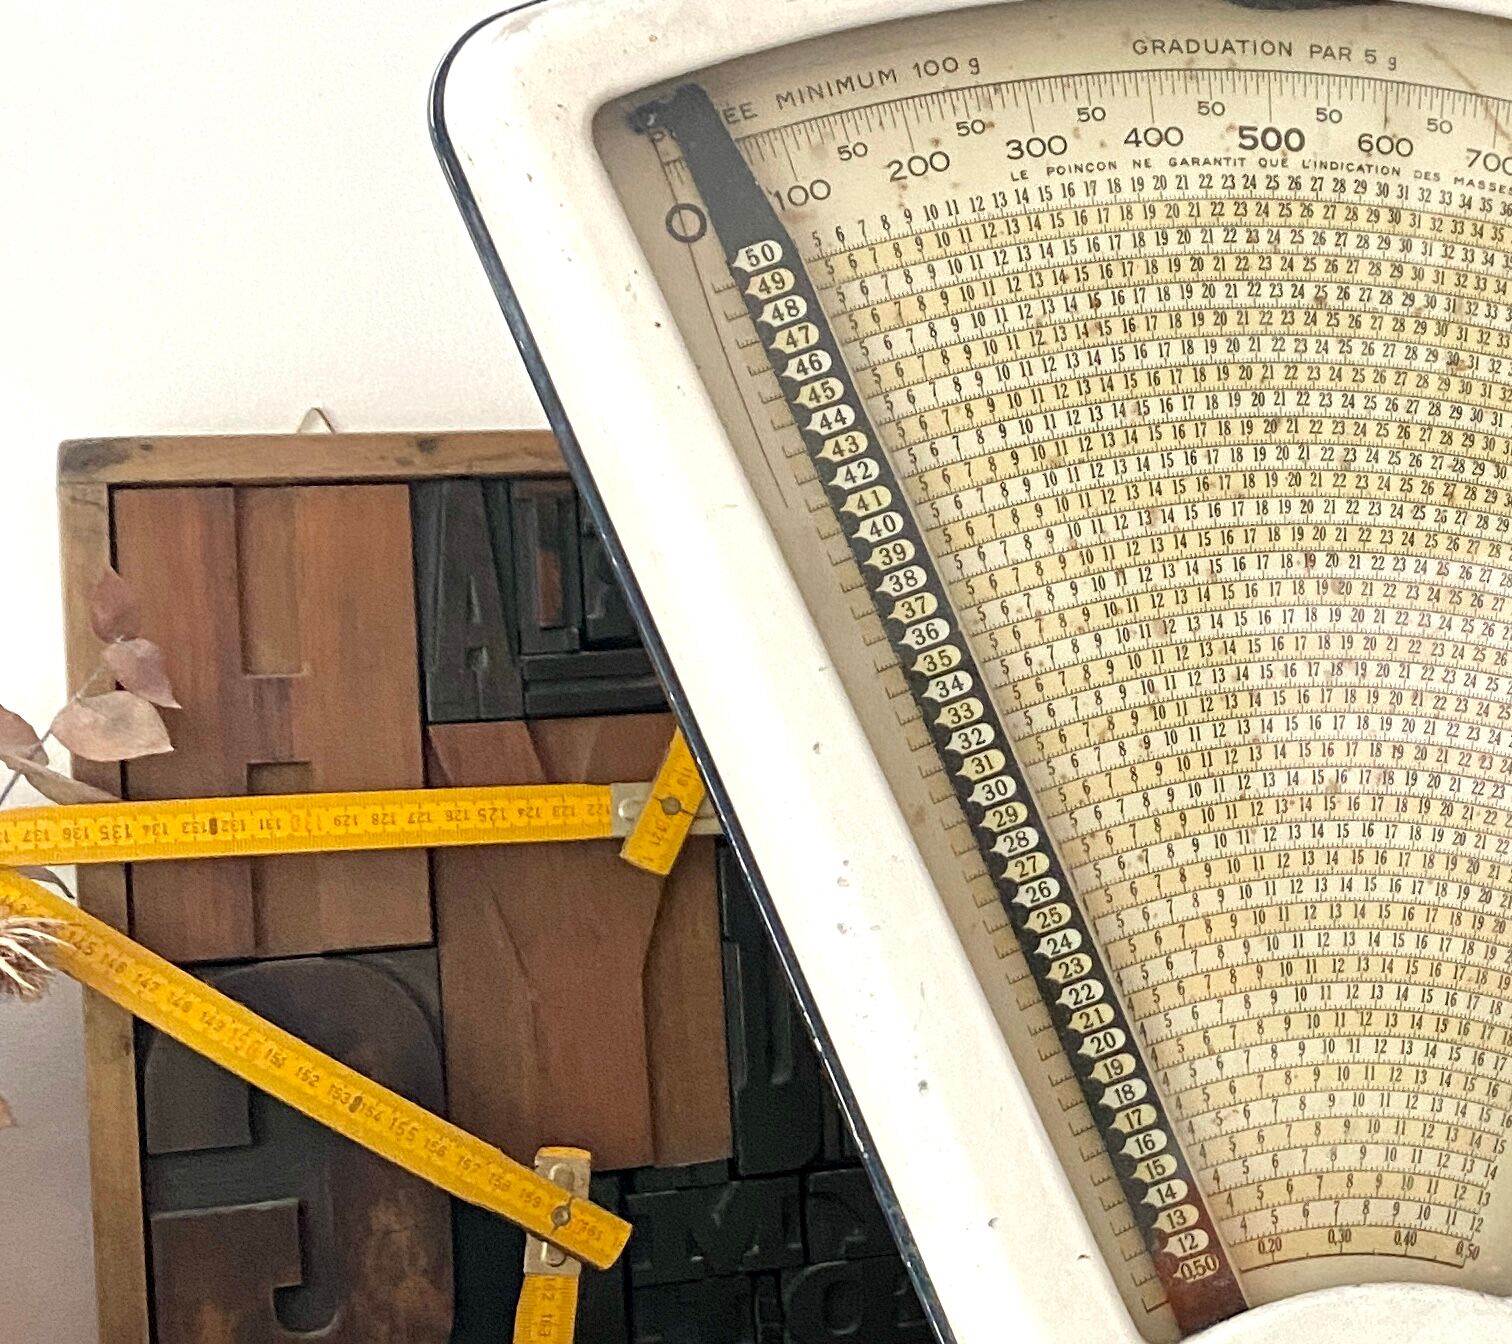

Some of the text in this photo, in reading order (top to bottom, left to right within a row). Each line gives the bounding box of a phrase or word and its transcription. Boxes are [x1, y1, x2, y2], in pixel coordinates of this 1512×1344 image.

[1133, 39, 1397, 71] GRADUATION PAR 5 g
[775, 56, 980, 110] MINIMUM 100 g
[769, 179, 831, 211] 100
[837, 142, 868, 161] 50
[886, 150, 950, 182] 200
[956, 119, 985, 137] 50
[1005, 135, 1067, 160] 300
[1077, 106, 1106, 123] 50
[1124, 126, 1184, 148] 400
[1197, 101, 1226, 116] 50
[1238, 125, 1306, 152] 500
[1316, 107, 1343, 124] 50
[1358, 133, 1413, 157] 600
[1426, 118, 1453, 134] 50
[1010, 169, 1029, 182] LE
[1132, 158, 1152, 169] NE
[1168, 157, 1246, 168] GARANTIT
[1259, 158, 1289, 168] QUE
[1302, 158, 1401, 177] L'INDICATION
[1413, 170, 1440, 182] DES
[812, 231, 821, 247] 5
[835, 226, 845, 242] 6
[857, 219, 866, 236] 7
[880, 215, 890, 231] 8
[903, 208, 913, 224] 9
[923, 204, 939, 221] 10
[945, 199, 960, 217] 11
[969, 195, 986, 213] 12
[992, 191, 1008, 208] 13
[1014, 187, 1029, 205] 14
[1038, 185, 1053, 202] 15
[1061, 182, 1076, 199] 16
[1083, 180, 1097, 197] 17
[1107, 177, 1122, 194] 18
[1130, 176, 1145, 192] 19
[1152, 174, 1167, 190] 20
[1175, 174, 1189, 190] 21
[1199, 173, 1214, 189] 22
[1221, 174, 1236, 189] 23
[1241, 174, 1257, 190] 24
[1266, 174, 1279, 190] 25
[1288, 175, 1301, 190] 26
[1310, 176, 1324, 192] 27
[1332, 177, 1346, 193] 28
[1354, 179, 1368, 194] 29
[1376, 181, 1390, 198] 30
[1397, 184, 1409, 201] 31
[1417, 187, 1432, 203] 32
[1438, 189, 1453, 206] 33
[1458, 193, 1472, 210] 34
[1479, 197, 1493, 213] 35
[745, 242, 775, 268] 50
[758, 271, 786, 295] 49
[771, 298, 800, 321] 48
[785, 326, 811, 349] 47
[796, 352, 823, 376] 46
[808, 380, 835, 403] 45
[819, 407, 847, 431] 44
[831, 434, 860, 457] 43
[844, 460, 873, 483] 42
[857, 490, 883, 512] 41
[869, 514, 896, 538] 40
[879, 541, 907, 566] 39
[889, 569, 917, 592] 38
[902, 596, 928, 618] 37
[914, 622, 940, 646] 36
[923, 649, 952, 672] 35
[935, 674, 964, 698] 34
[948, 702, 975, 725] 33
[958, 727, 985, 750] 32
[970, 755, 993, 776] 31
[981, 779, 1008, 802] 30
[992, 806, 1019, 829] 29
[1003, 831, 1030, 853] 28
[1014, 856, 1038, 878] 27
[1026, 880, 1052, 902] 26
[1036, 906, 1063, 929] 25
[1047, 932, 1072, 954] 24
[1058, 958, 1085, 980] 23
[1069, 984, 1094, 1006] 22
[1080, 1008, 1105, 1029] 21
[1090, 1031, 1116, 1055] 20
[1102, 1058, 1124, 1080] 19
[1113, 1083, 1136, 1105] 18
[1124, 1109, 1143, 1129] 17
[1135, 1135, 1156, 1155] 16
[1145, 1159, 1167, 1180] 15
[1155, 1184, 1177, 1204] 14
[1165, 1209, 1187, 1230] 13
[1240, 1201, 1483, 1232] 4 5 6 7 8 9 10 11 12
[1176, 1232, 1197, 1253] 12
